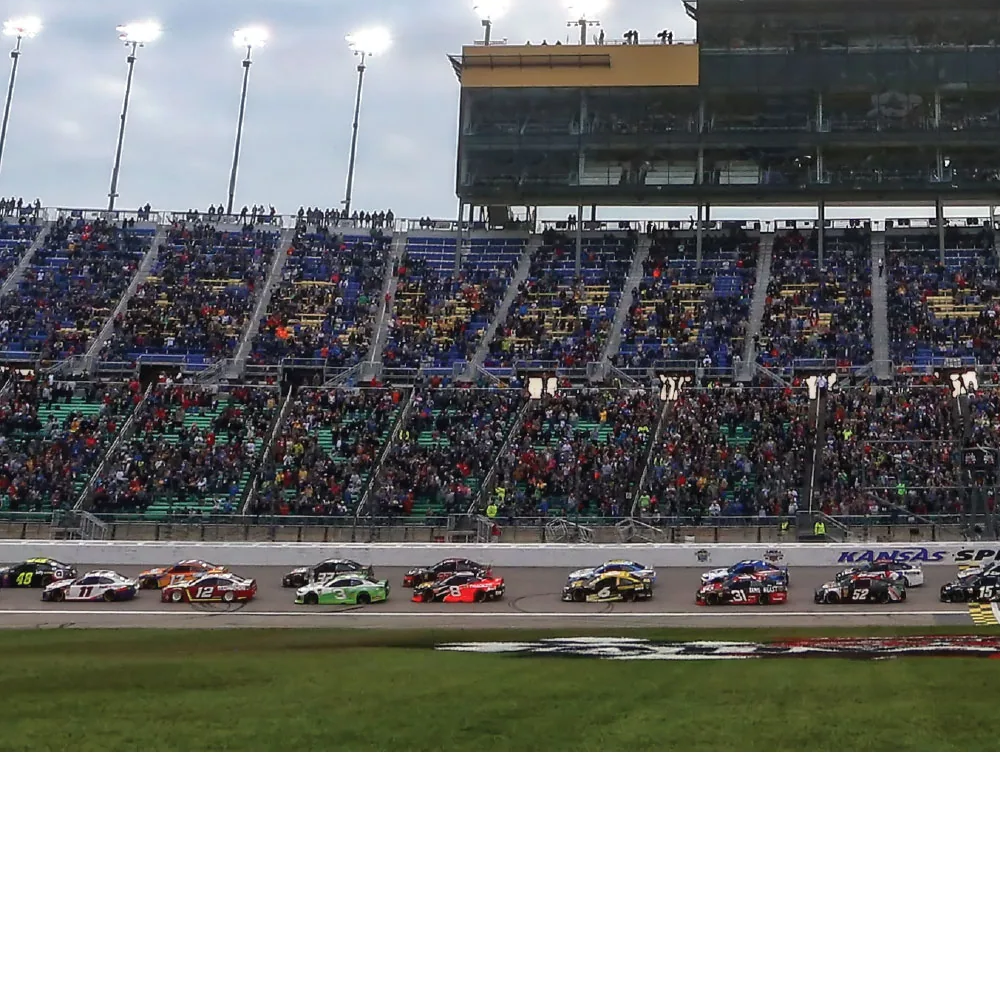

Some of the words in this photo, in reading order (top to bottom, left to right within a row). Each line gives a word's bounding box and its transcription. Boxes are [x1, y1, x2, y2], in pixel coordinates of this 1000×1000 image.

[837, 547, 947, 563] KANSAS
[16, 572, 34, 585] 48
[79, 586, 94, 598] 11
[196, 586, 214, 598] 12
[333, 588, 346, 600] 3
[449, 585, 462, 597] 8
[597, 586, 611, 598] 6
[731, 589, 747, 602] 31
[852, 588, 869, 600] 52
[980, 585, 995, 598] 15
